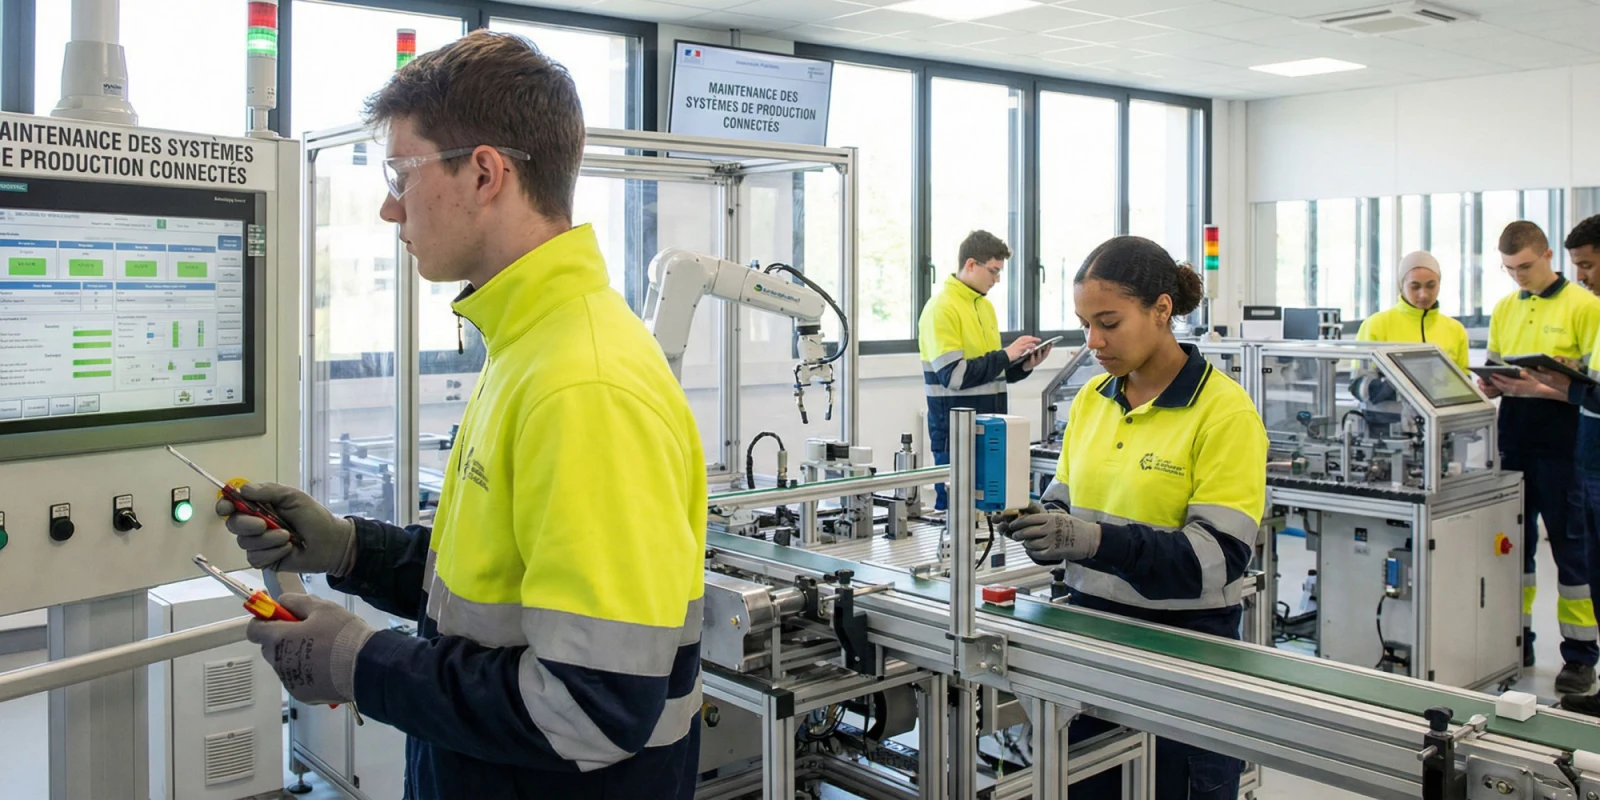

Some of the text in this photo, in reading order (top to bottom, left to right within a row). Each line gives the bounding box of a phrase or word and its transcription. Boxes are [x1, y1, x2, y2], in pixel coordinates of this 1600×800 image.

[709, 82, 799, 103] MAINTENANCE DES
[686, 95, 817, 120] SYSTÈMES DE PRODUCTION
[723, 117, 780, 133] CONNECTÉS
[129, 134, 162, 155] DES
[168, 137, 254, 163] SYSTÈMES
[20, 148, 143, 177] PRODUCTION
[150, 161, 247, 184] CONNECTÉS
